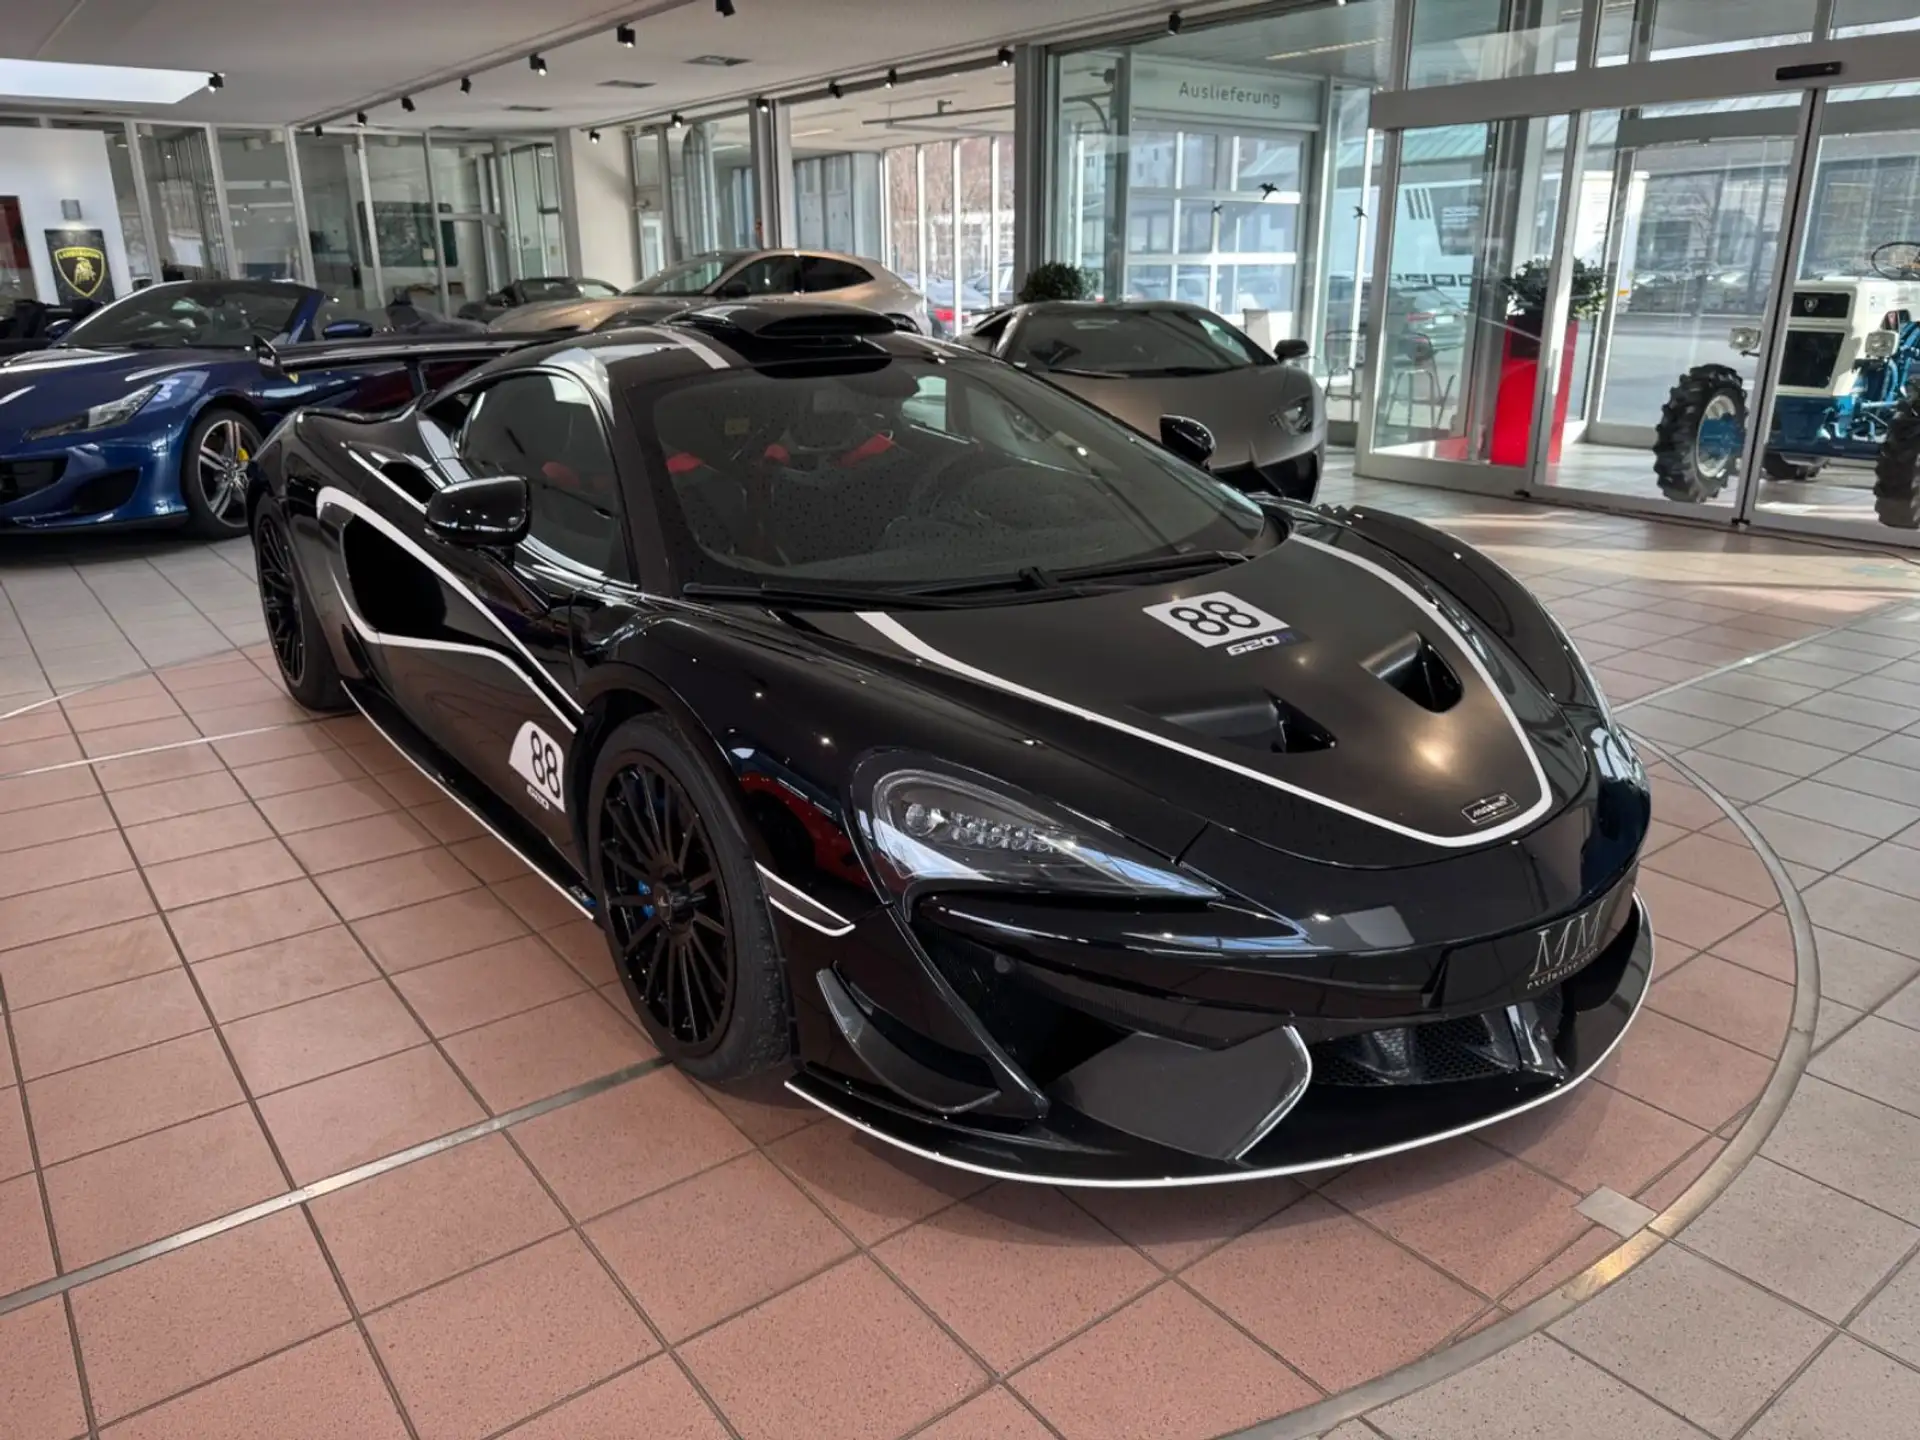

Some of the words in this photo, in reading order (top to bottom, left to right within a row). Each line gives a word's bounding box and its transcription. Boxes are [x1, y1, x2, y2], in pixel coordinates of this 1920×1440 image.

[1179, 81, 1280, 109] Auslieferung
[1169, 601, 1261, 636] 88
[531, 730, 561, 799] 88
[1529, 899, 1608, 977] MM
